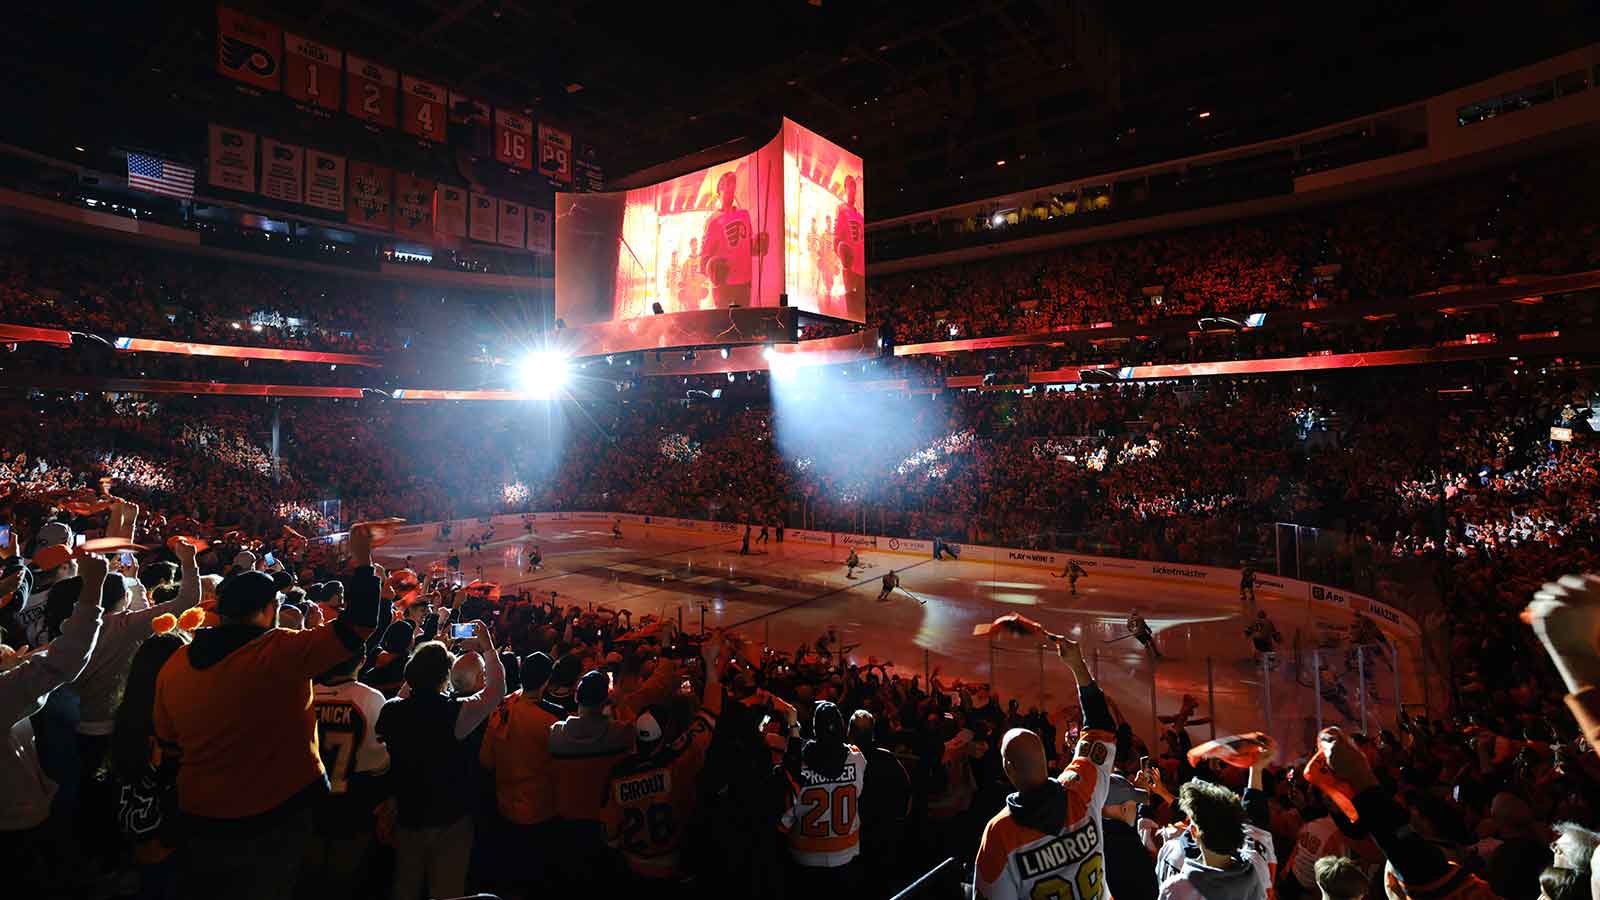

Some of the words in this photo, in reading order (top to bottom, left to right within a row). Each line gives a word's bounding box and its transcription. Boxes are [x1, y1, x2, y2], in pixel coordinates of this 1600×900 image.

[305, 64, 320, 97] 1
[361, 83, 384, 115] 2
[416, 103, 433, 132] 4
[503, 131, 526, 161] 16
[1152, 566, 1207, 578] ticketmaster
[1325, 591, 1344, 603] App
[801, 765, 855, 785] PROER
[800, 784, 857, 837] 20
[1022, 825, 1097, 876] LINDROS
